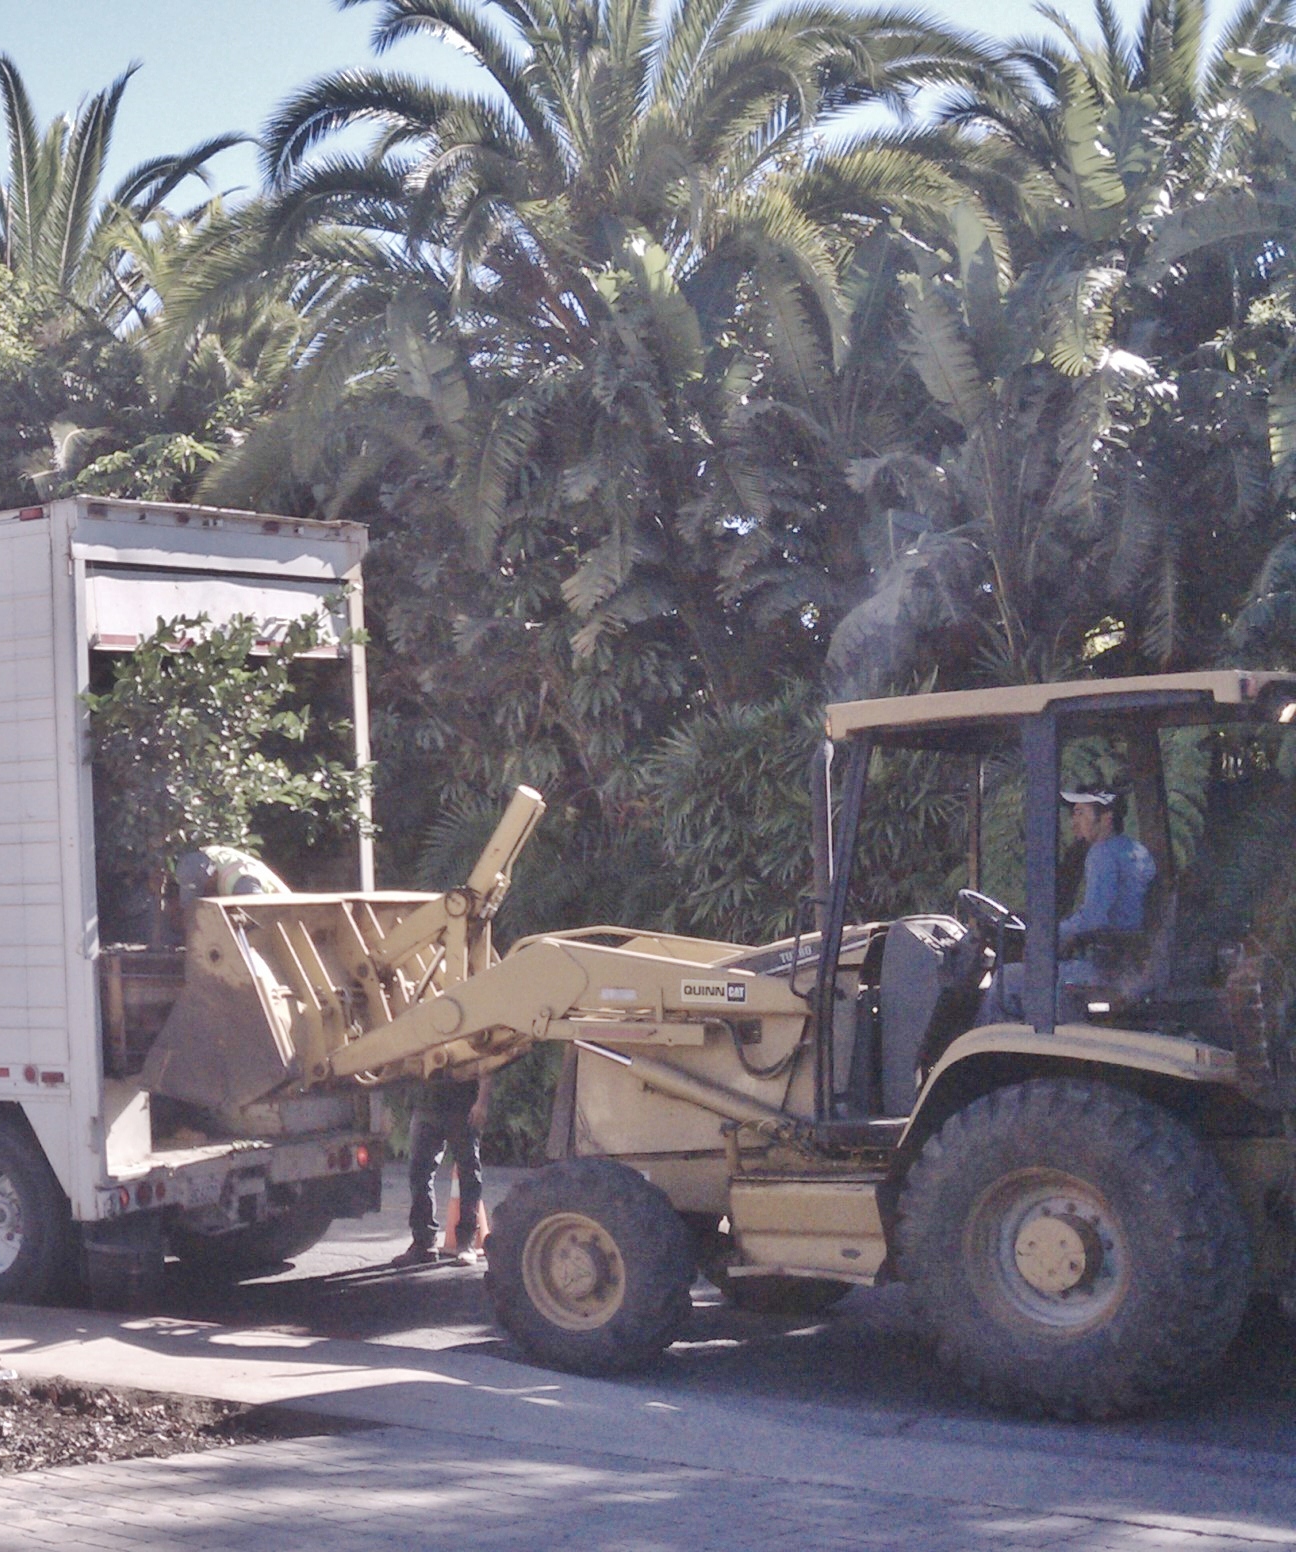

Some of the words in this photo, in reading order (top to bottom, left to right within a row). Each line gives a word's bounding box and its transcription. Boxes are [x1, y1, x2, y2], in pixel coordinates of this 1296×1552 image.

[779, 945, 812, 964] TUBO
[684, 985, 725, 997] QUINN
[728, 986, 745, 998] CAT
